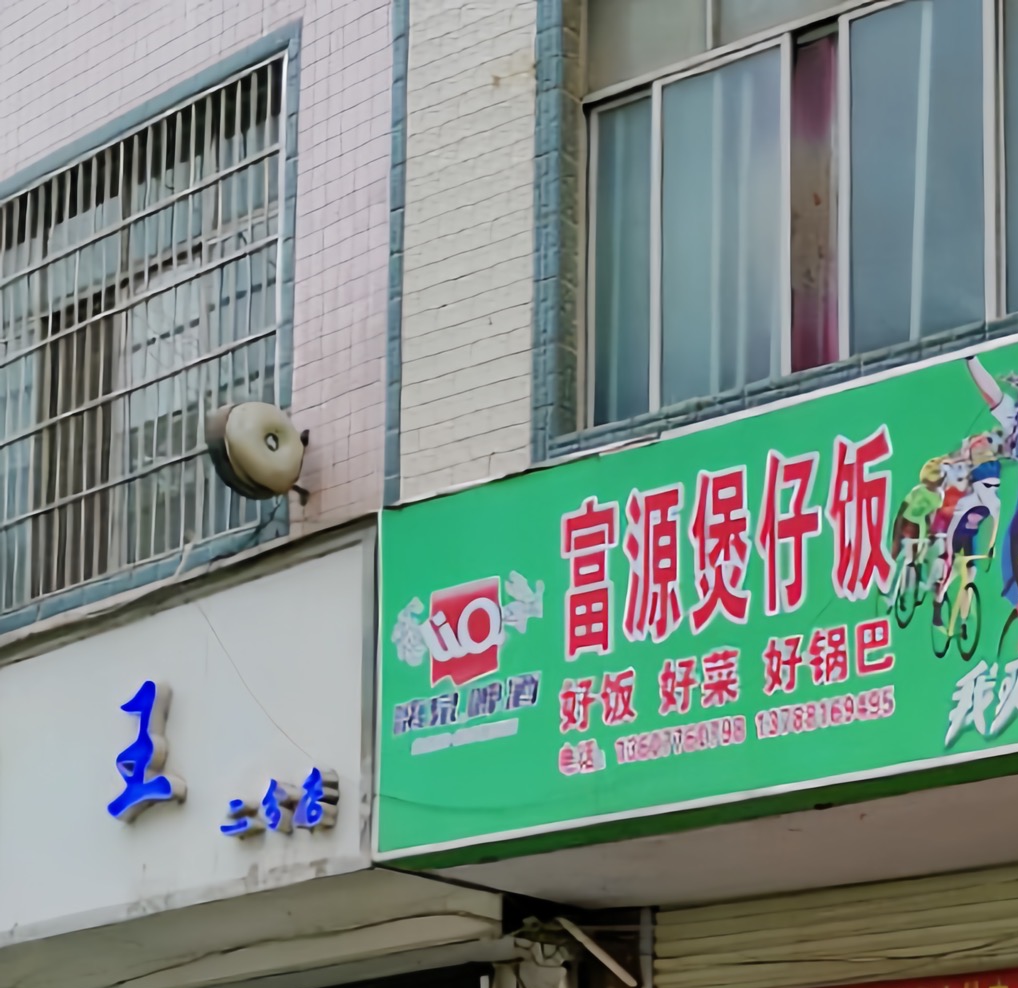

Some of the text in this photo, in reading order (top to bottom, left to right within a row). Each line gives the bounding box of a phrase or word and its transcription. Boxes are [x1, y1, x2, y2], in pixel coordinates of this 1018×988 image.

[561, 424, 896, 661] 富源煲仔饭
[559, 619, 895, 733] 好饭 好菜 好锅巴
